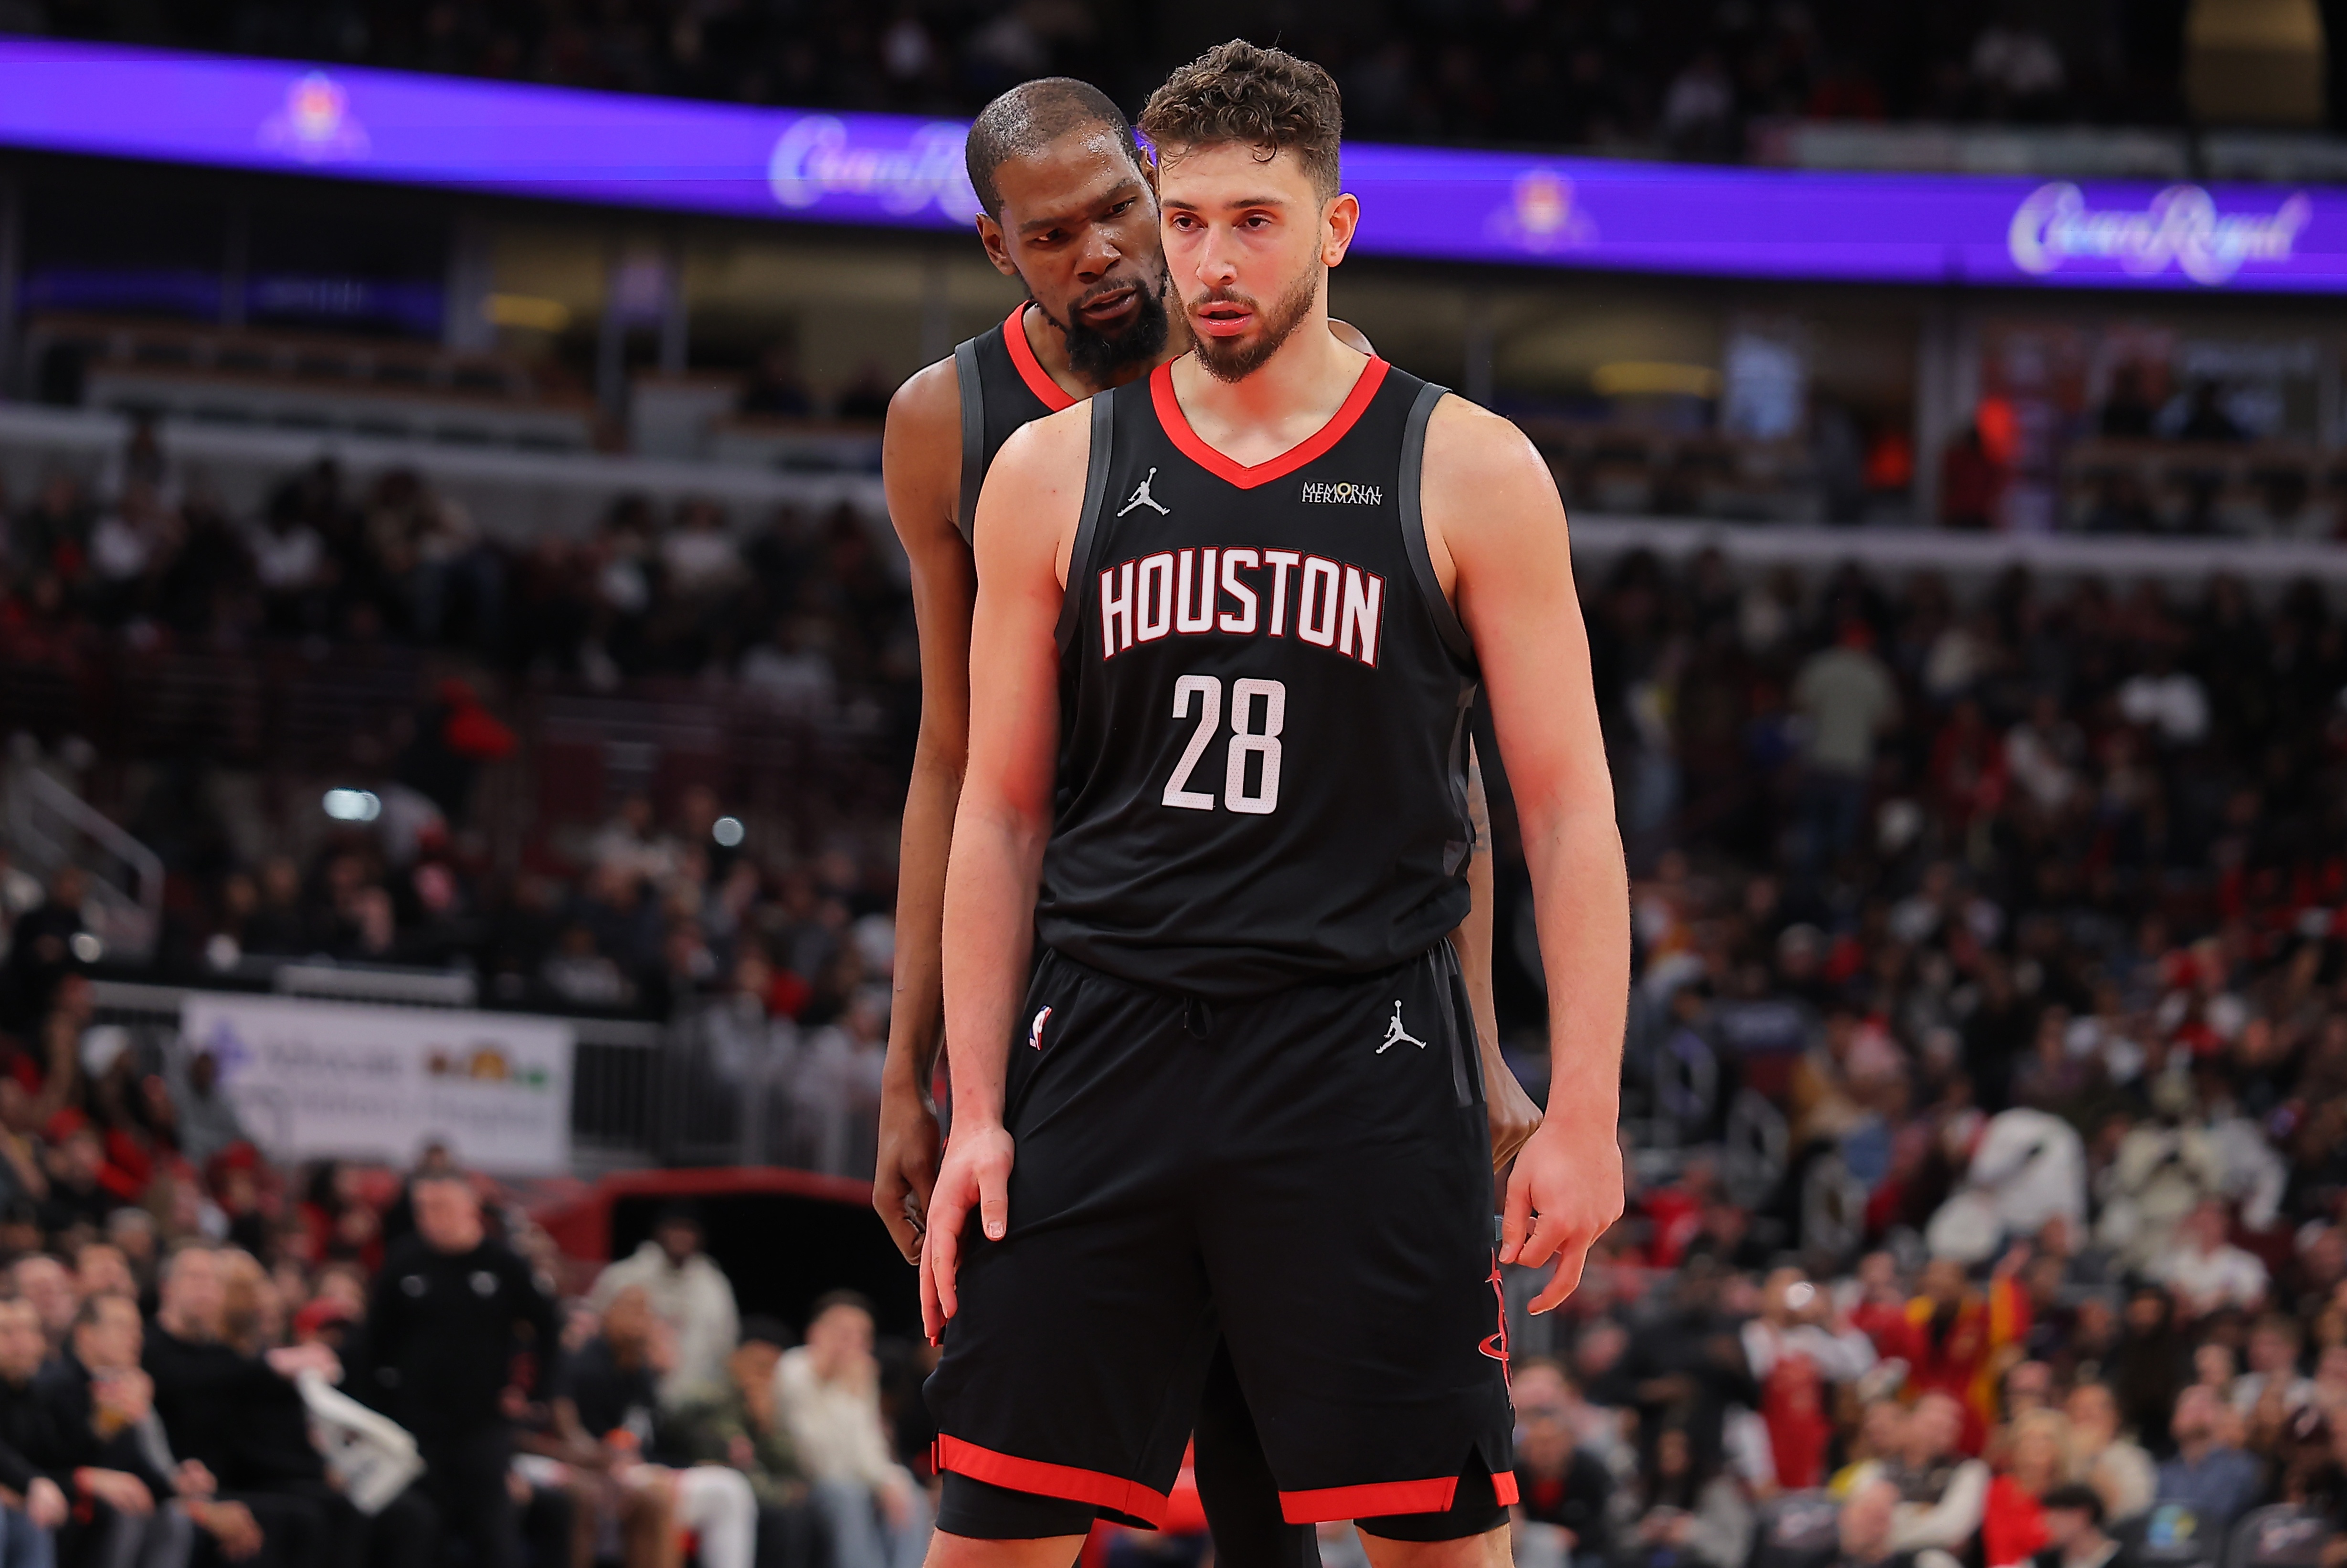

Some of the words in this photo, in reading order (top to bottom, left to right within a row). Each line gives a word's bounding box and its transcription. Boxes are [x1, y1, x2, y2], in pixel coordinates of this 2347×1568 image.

[1301, 491, 1381, 505] HERMANN
[1302, 482, 1383, 497] MEMORIAL
[1099, 546, 1386, 669] HOUSTON
[1162, 675, 1286, 814] 28
